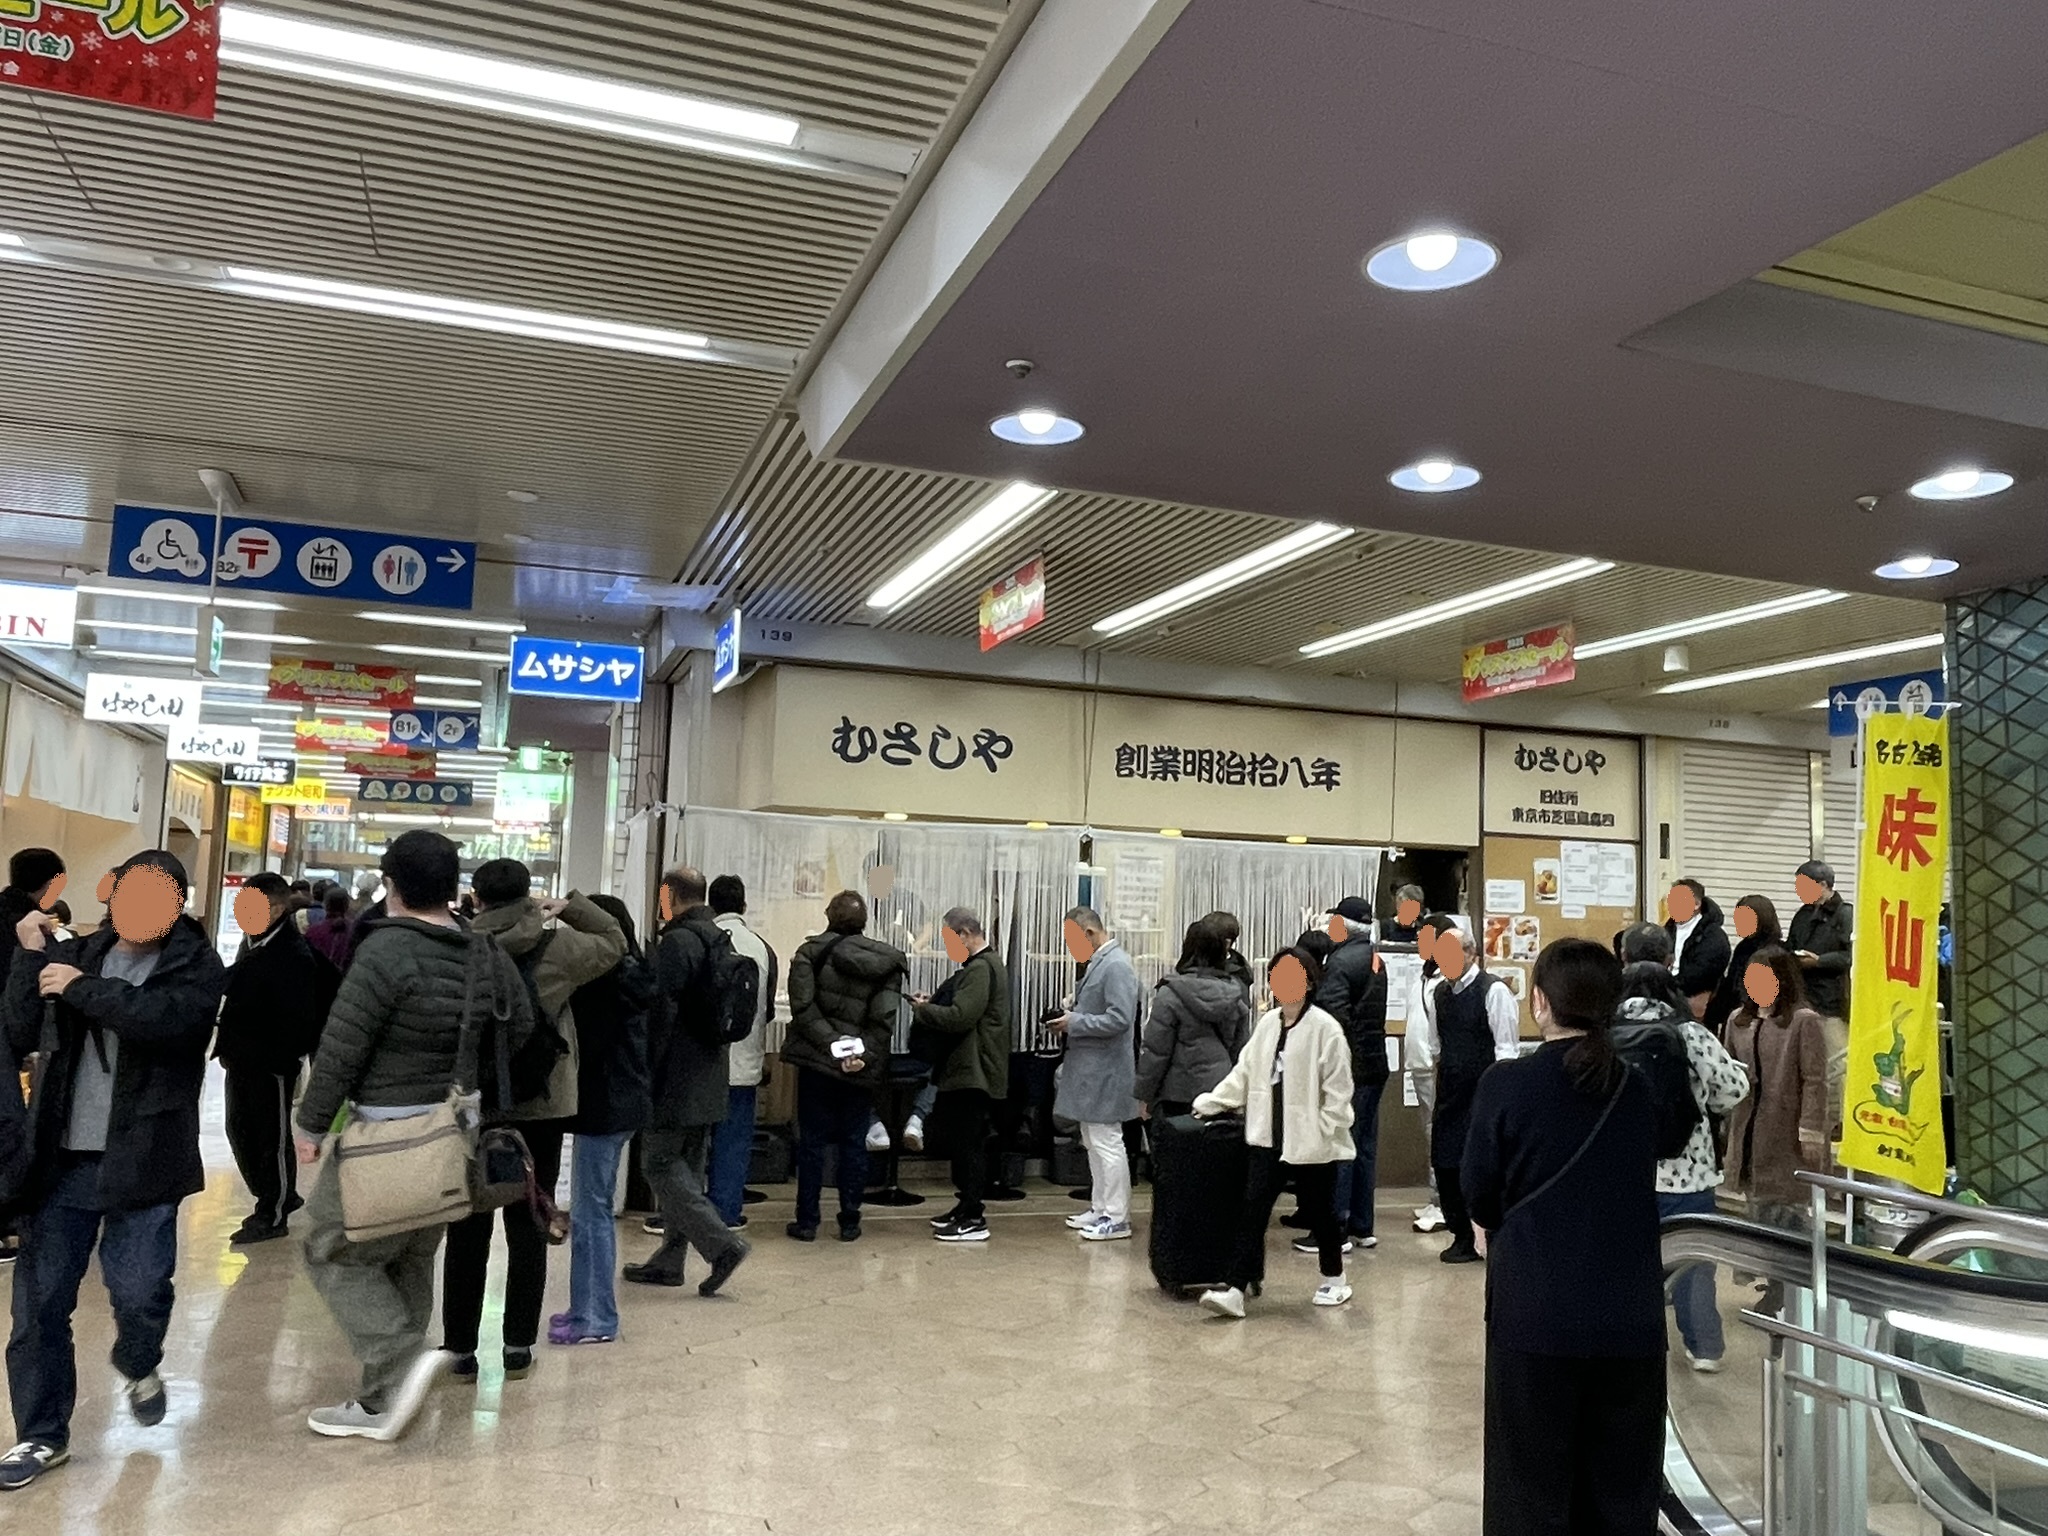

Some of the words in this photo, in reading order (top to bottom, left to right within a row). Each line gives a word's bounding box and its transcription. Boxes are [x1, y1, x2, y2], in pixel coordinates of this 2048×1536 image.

[0, 26, 73, 59] 日(金)
[135, 552, 153, 566] 4F
[0, 614, 47, 638] IN
[760, 628, 793, 642] 139
[517, 651, 636, 686] ムサシヤ
[395, 720, 418, 734] B1F
[443, 723, 460, 736] 2F
[831, 715, 1014, 774] むさしや
[1115, 741, 1341, 792] 創業明治拾八年
[1514, 743, 1607, 776] むさしや
[1539, 789, 1579, 806] 旧住所
[1876, 787, 1938, 989] 味山
